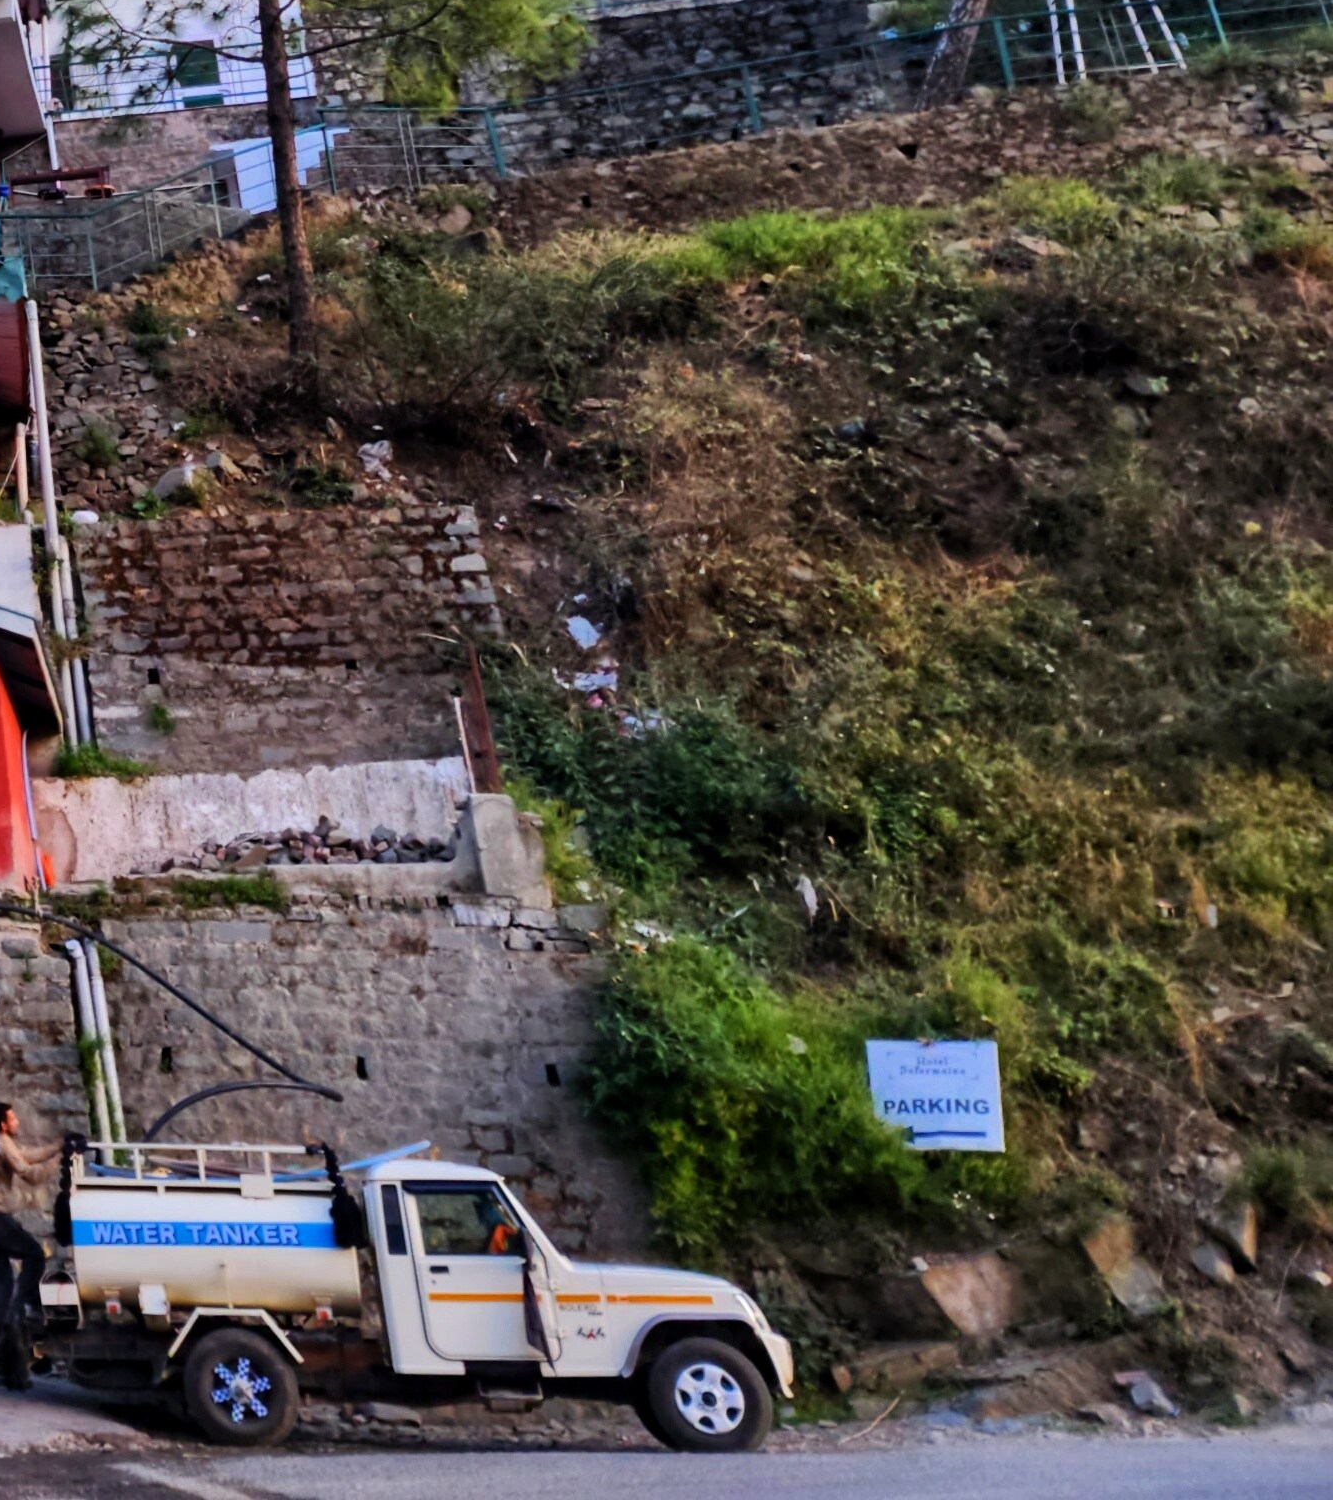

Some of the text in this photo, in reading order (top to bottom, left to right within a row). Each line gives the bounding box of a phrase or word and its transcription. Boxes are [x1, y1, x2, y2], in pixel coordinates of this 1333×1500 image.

[883, 1097, 990, 1115] PARKING
[92, 1222, 300, 1246] WATER TANKER
